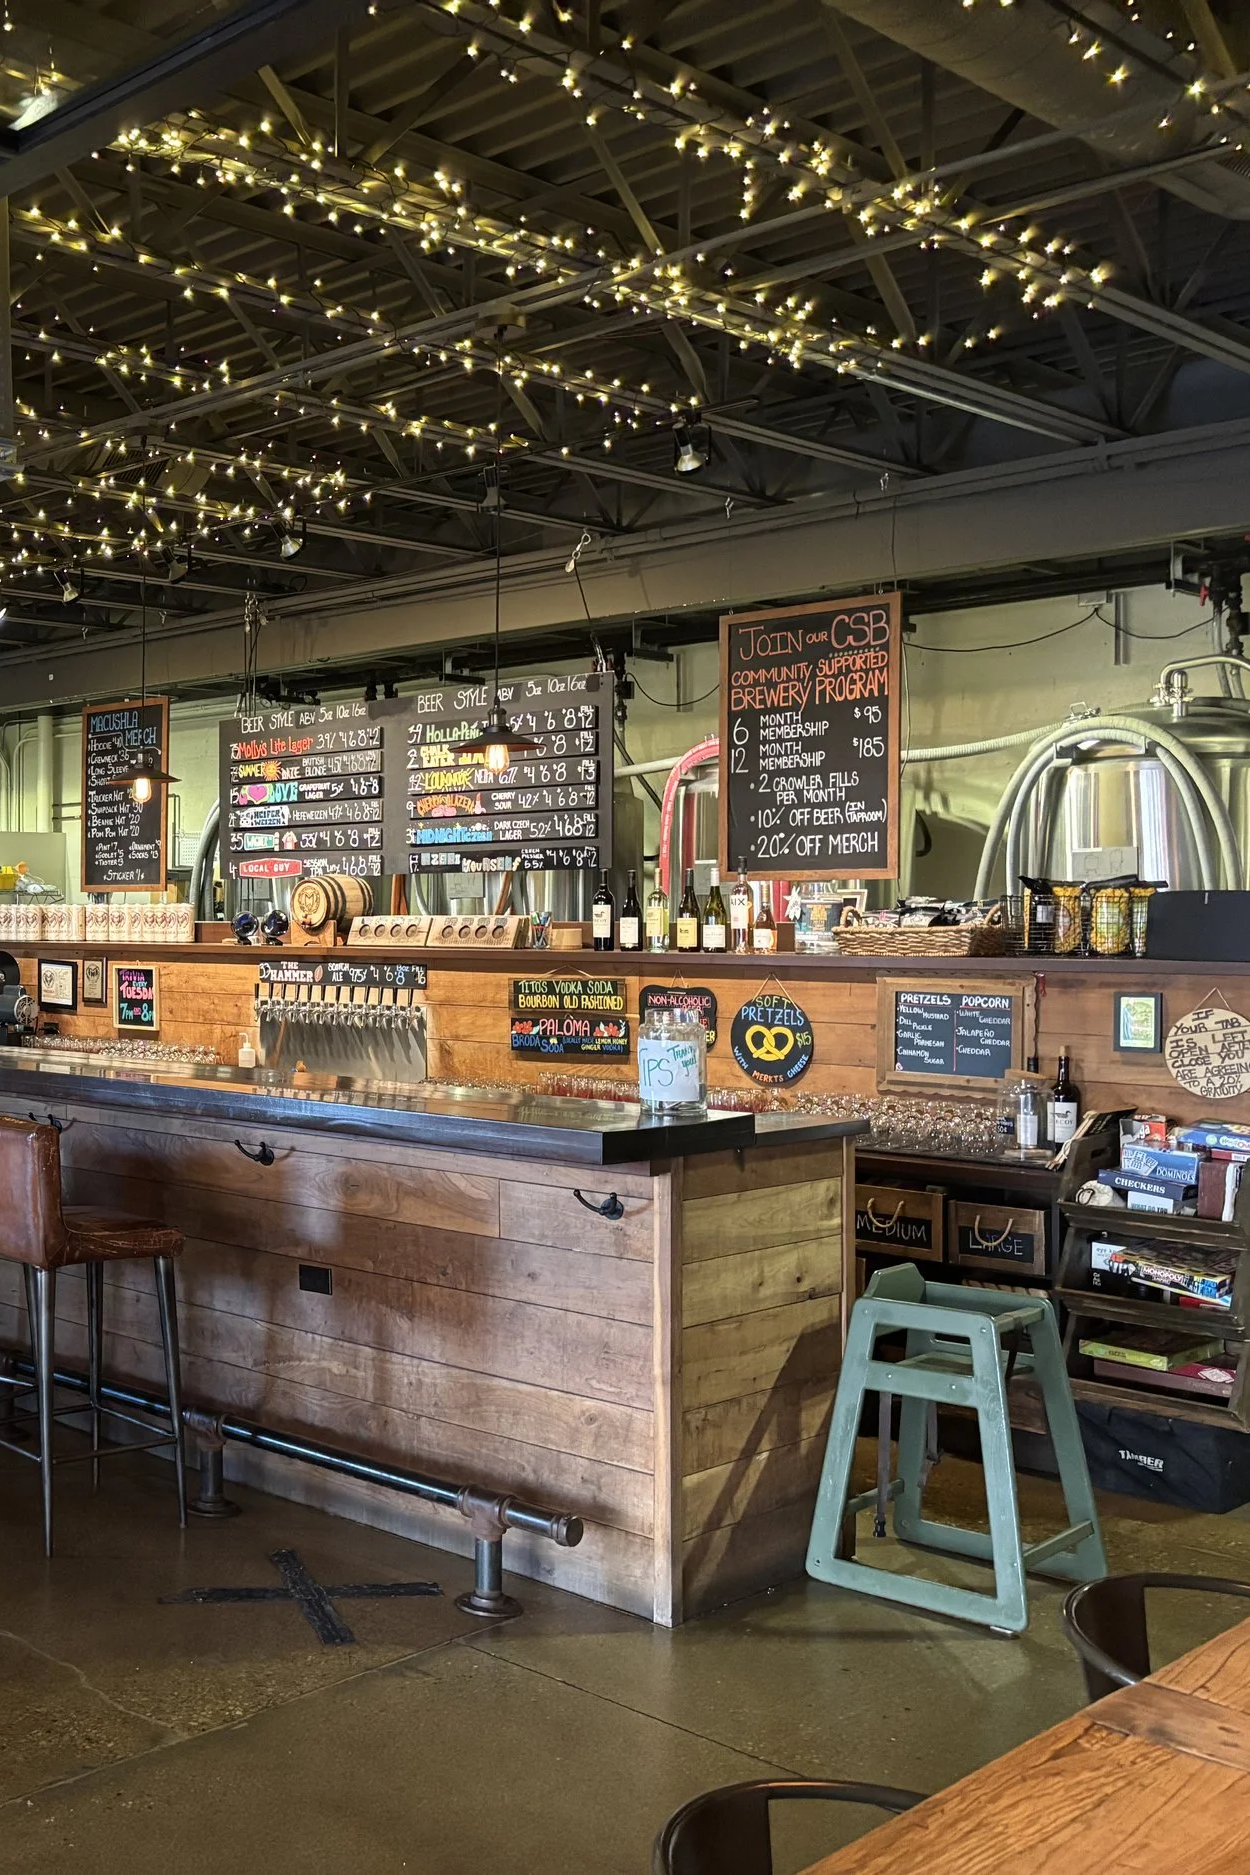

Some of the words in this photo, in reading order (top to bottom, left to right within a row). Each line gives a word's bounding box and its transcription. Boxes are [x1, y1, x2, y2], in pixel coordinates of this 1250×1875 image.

[739, 625, 803, 660] JOIN
[806, 631, 828, 644] OUR
[831, 610, 890, 649] CSB
[731, 661, 813, 687] COMMUNITY
[816, 651, 888, 676] SUPPORTED
[731, 680, 813, 712] BREWERY
[816, 668, 888, 704] PROGRAM
[418, 694, 443, 714] BEER
[454, 687, 488, 710] STYLE
[90, 711, 138, 732] MACUSHLA
[760, 711, 802, 727] MONTH
[854, 706, 882, 724] $95
[242, 716, 265, 734] BEER
[268, 711, 294, 730] STYLE
[300, 712, 316, 725] ABV
[733, 718, 749, 745] 6
[760, 720, 830, 741] MEMBERSHIP
[270, 738, 286, 755] Lite
[288, 736, 314, 754] Lager
[759, 742, 801, 756] MONTH
[853, 736, 884, 758] $185
[302, 756, 325, 766] BRITISH
[731, 748, 749, 774] 12
[759, 750, 826, 771] MEMBERSHIP
[90, 766, 105, 776] LONG
[238, 764, 266, 778] SUMMER
[306, 766, 327, 776] BLONDE
[758, 774, 771, 792] 2
[772, 774, 823, 792] CROWLER
[830, 771, 860, 787] FILLS
[89, 790, 112, 802] TRUCKER
[113, 790, 124, 801] HAT
[305, 791, 324, 800] LAGER
[492, 792, 516, 800] CHERRY
[776, 792, 798, 805] PER
[804, 788, 846, 802] MONTH
[119, 802, 130, 814] HAT
[494, 802, 512, 810] SOUR
[92, 816, 114, 826] BEANIE
[115, 814, 126, 825] HAT
[758, 806, 786, 828] 10%
[789, 808, 812, 826] OFF
[814, 808, 844, 825] BEER
[494, 821, 512, 830] DARK
[512, 820, 530, 828] CZECH
[91, 828, 104, 838] POM
[105, 827, 116, 837] POM
[118, 826, 129, 837] HAT
[416, 829, 466, 844] MIDNIGHT
[500, 830, 522, 840] LAGER
[98, 843, 110, 851] PINT
[757, 833, 796, 858] 20%
[796, 835, 824, 856] OFF
[828, 832, 878, 855] MERCH
[132, 850, 149, 859] SOCKS
[244, 863, 268, 872] LOCAL
[274, 862, 290, 872] GUY
[304, 858, 328, 868] SESSION
[108, 870, 134, 880] STICKER
[310, 866, 324, 878] IPA
[281, 962, 298, 970] THE
[328, 962, 350, 971] SCOTCH
[270, 970, 314, 982] HAMMER
[332, 972, 344, 982] ALE
[519, 981, 548, 994] TITO'S
[552, 980, 582, 994] VODKA
[587, 980, 613, 994] SODA
[518, 995, 559, 1009] BOURBON
[564, 996, 578, 1009] OLD
[581, 996, 624, 1010] FASHIONED
[648, 995, 710, 1006] NON-ALCOHOLIC
[756, 996, 790, 1009] SOFT
[901, 994, 952, 1005] PRETZELS
[962, 996, 1009, 1008] POPCORN
[899, 1004, 924, 1014] YELLOW
[959, 1010, 980, 1018] WHITE
[741, 1006, 804, 1026] PRETZELS
[899, 1016, 912, 1025] DILL
[922, 1012, 950, 1020] MUSTARD
[979, 1016, 1010, 1024] CHEDDAR
[1192, 1010, 1214, 1022] IF
[539, 1018, 590, 1036] PALOMA
[912, 1022, 932, 1030] PICKLE
[1174, 1022, 1208, 1036] YOUR
[1214, 1018, 1242, 1030] TAB
[796, 1031, 812, 1048] $15
[898, 1030, 922, 1039] GARLIC
[956, 1028, 995, 1038] JALAPEÑO
[512, 1034, 540, 1048] BRODA
[540, 1038, 564, 1054] SODA
[914, 1038, 944, 1047] PARMESAN
[980, 1037, 1010, 1046] CHEDDAR
[1170, 1038, 1197, 1050] IS
[1212, 1030, 1248, 1044] LEFT
[898, 1048, 930, 1058] CINNAMON
[958, 1046, 991, 1056] CHEDDAR
[1169, 1045, 1208, 1059] OPEN
[1220, 1041, 1250, 1054] AFTE
[734, 1046, 748, 1070] WITH
[752, 1070, 784, 1083] MERKTS
[786, 1054, 808, 1078] CHEESE
[1172, 1056, 1212, 1069] CLOSE
[1218, 1050, 1244, 1064] YOU
[1176, 1069, 1198, 1080] ARE
[1184, 1080, 1200, 1088] TO
[1206, 1079, 1215, 1087] A
[1219, 1075, 1241, 1088] 20%
[1200, 1084, 1243, 1097] GRATUITY
[1156, 1167, 1196, 1182] DOMINOES
[1114, 1177, 1166, 1194] CHECKERS
[856, 1214, 926, 1242] MEDIUM
[969, 1230, 1023, 1256] LARGE
[1143, 1266, 1183, 1282] MONOPOLY
